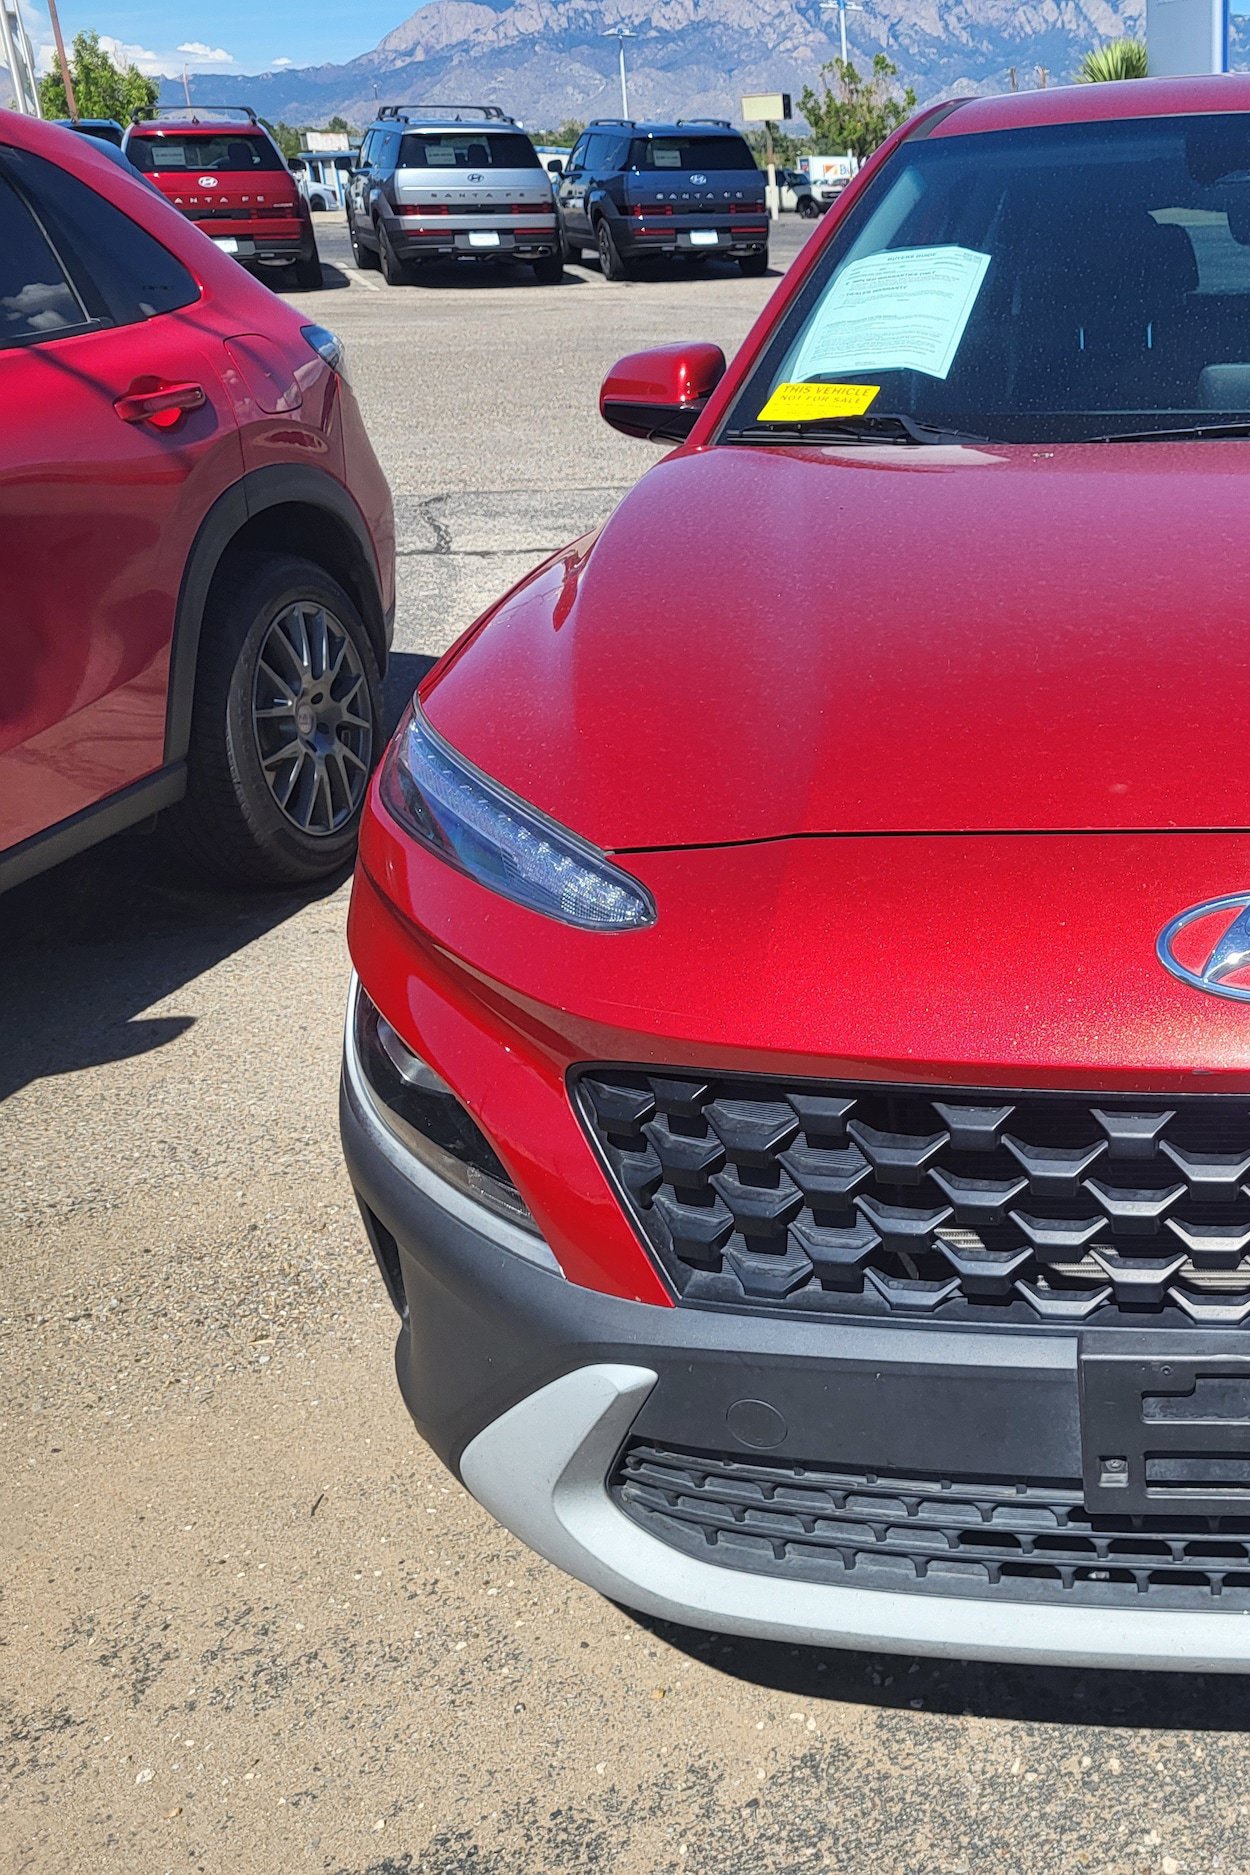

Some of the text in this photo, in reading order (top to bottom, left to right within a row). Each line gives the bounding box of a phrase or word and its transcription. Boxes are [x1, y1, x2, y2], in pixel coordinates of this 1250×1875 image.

[656, 192, 714, 200] SANTA
[783, 385, 872, 396] THIS VEHICLE
